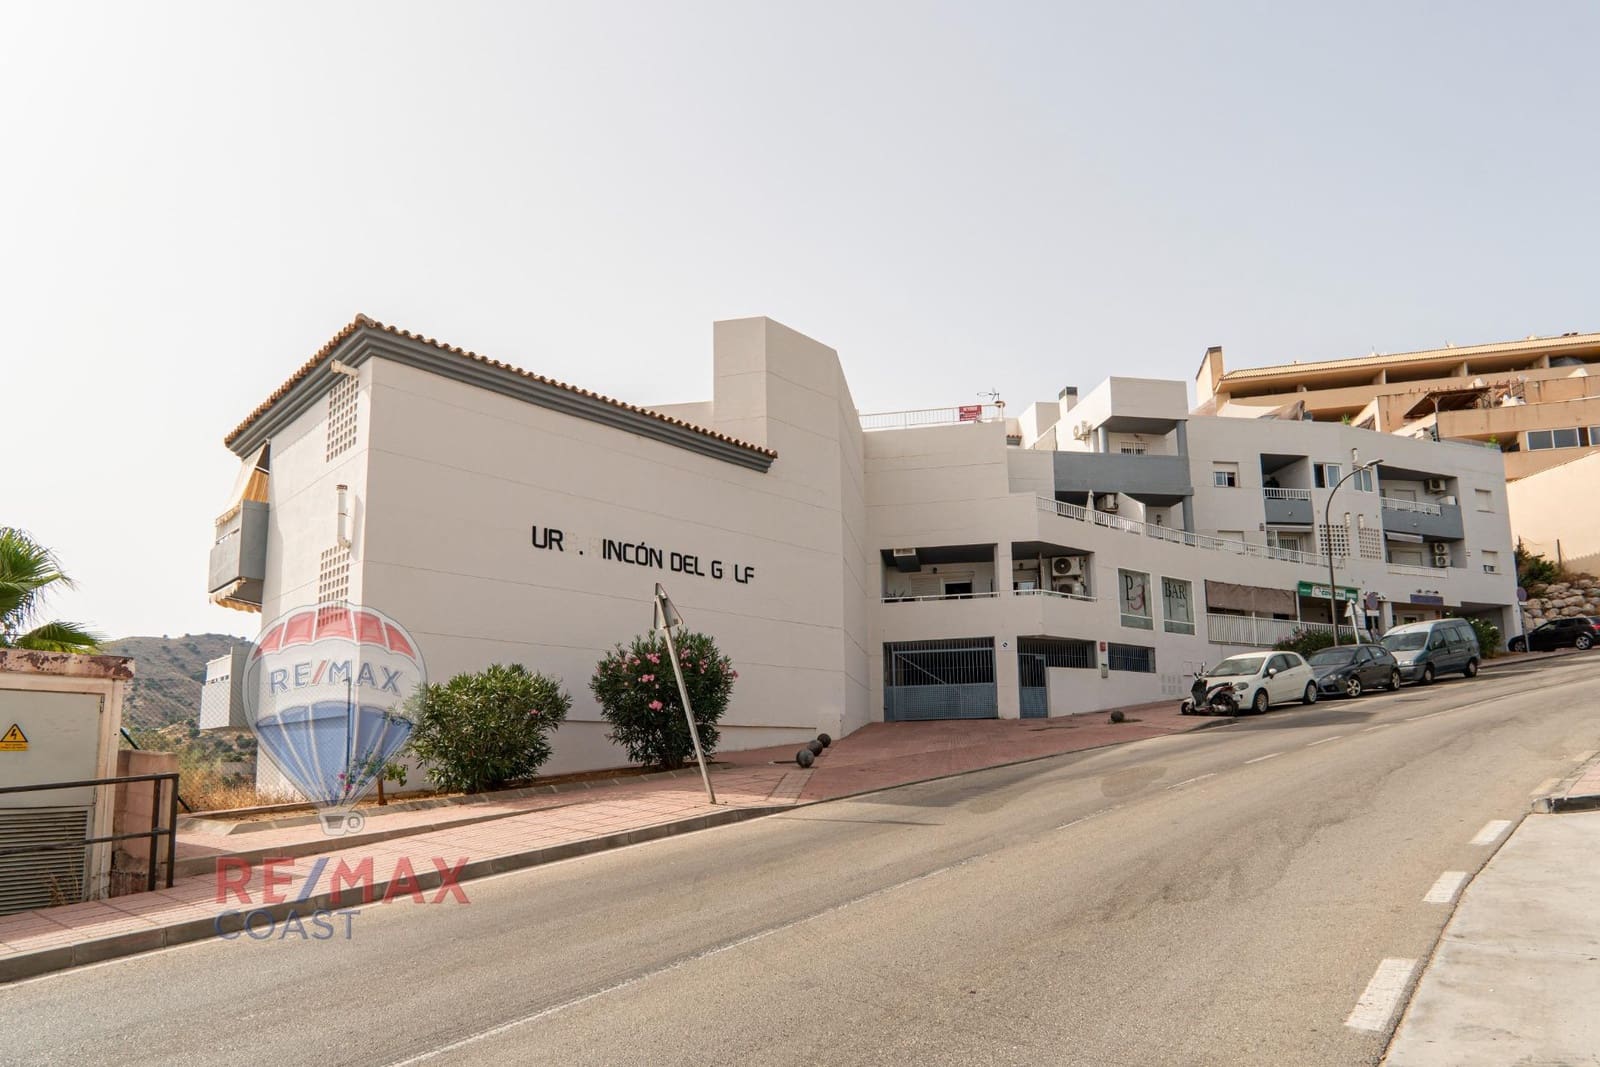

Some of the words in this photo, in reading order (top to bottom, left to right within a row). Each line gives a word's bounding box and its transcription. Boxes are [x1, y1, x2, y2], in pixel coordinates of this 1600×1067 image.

[590, 537, 663, 570] INCÓN
[670, 551, 706, 577] DEL
[1164, 582, 1187, 600] BAR
